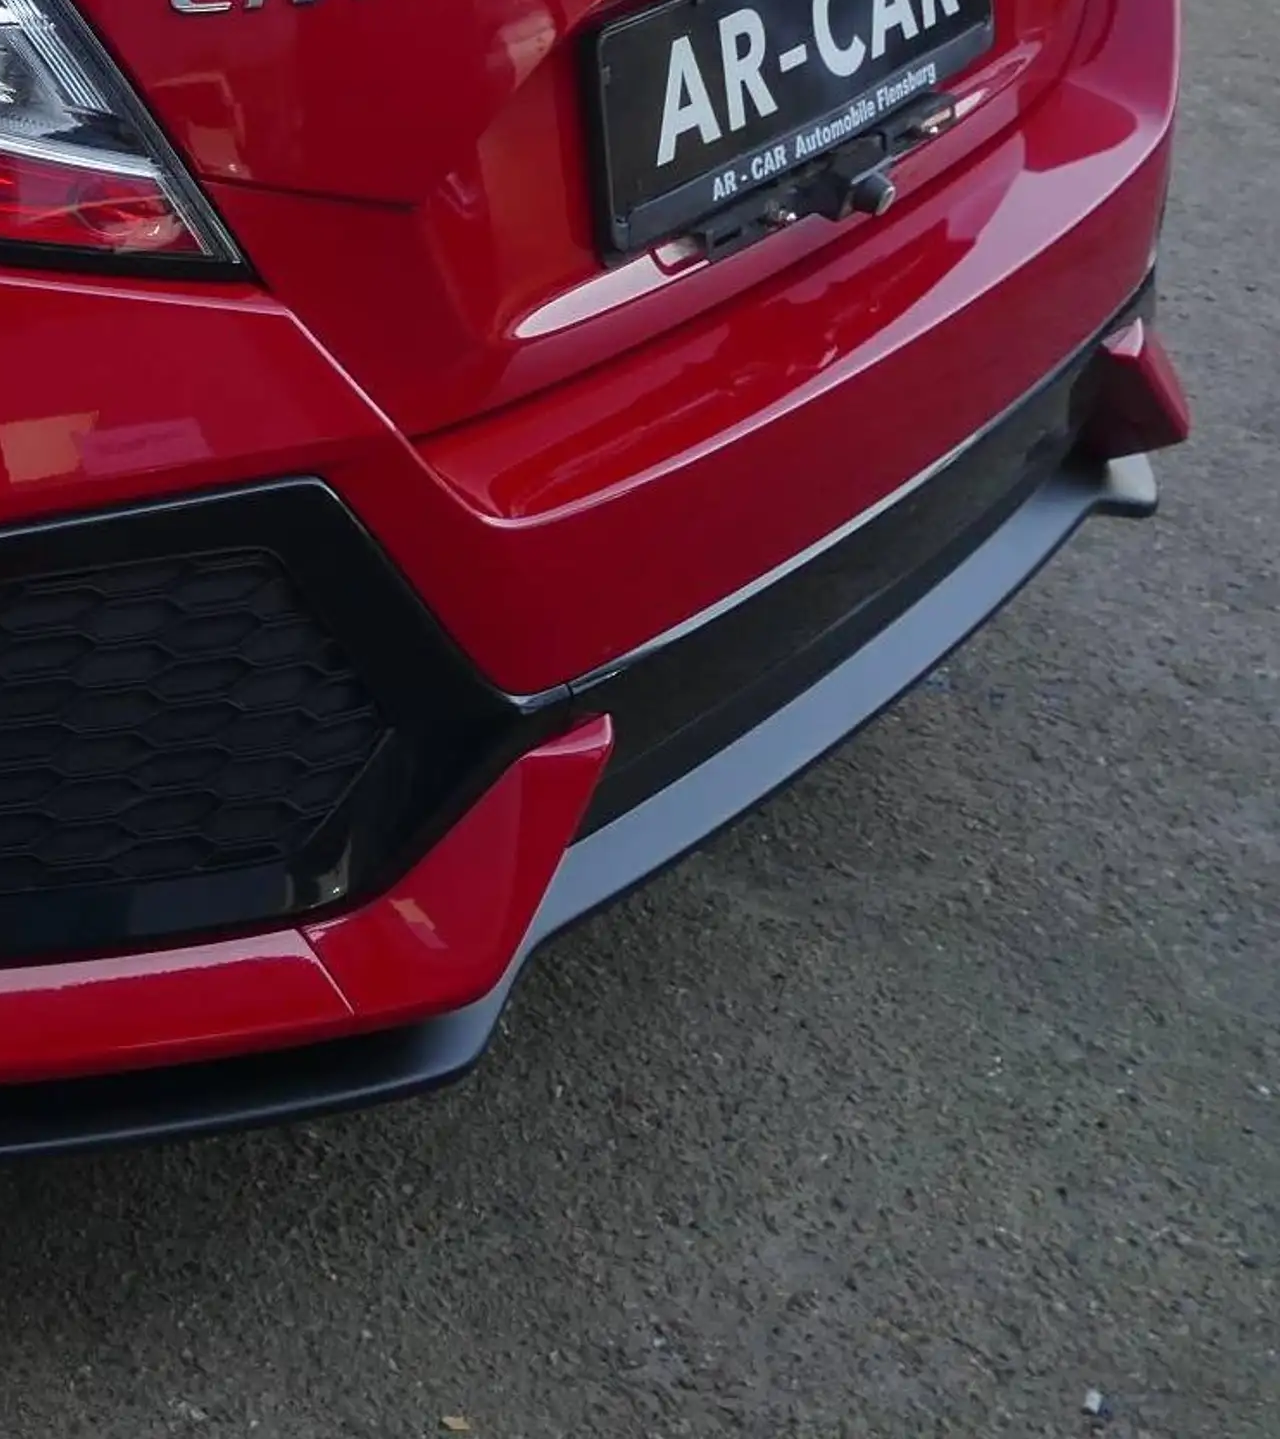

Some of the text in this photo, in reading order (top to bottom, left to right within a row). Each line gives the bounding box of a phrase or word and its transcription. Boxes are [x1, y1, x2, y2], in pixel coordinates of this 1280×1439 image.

[712, 169, 739, 202] AR
[750, 144, 789, 181] CAR
[794, 98, 878, 160] Automobile
[875, 62, 937, 112] Flensburg
